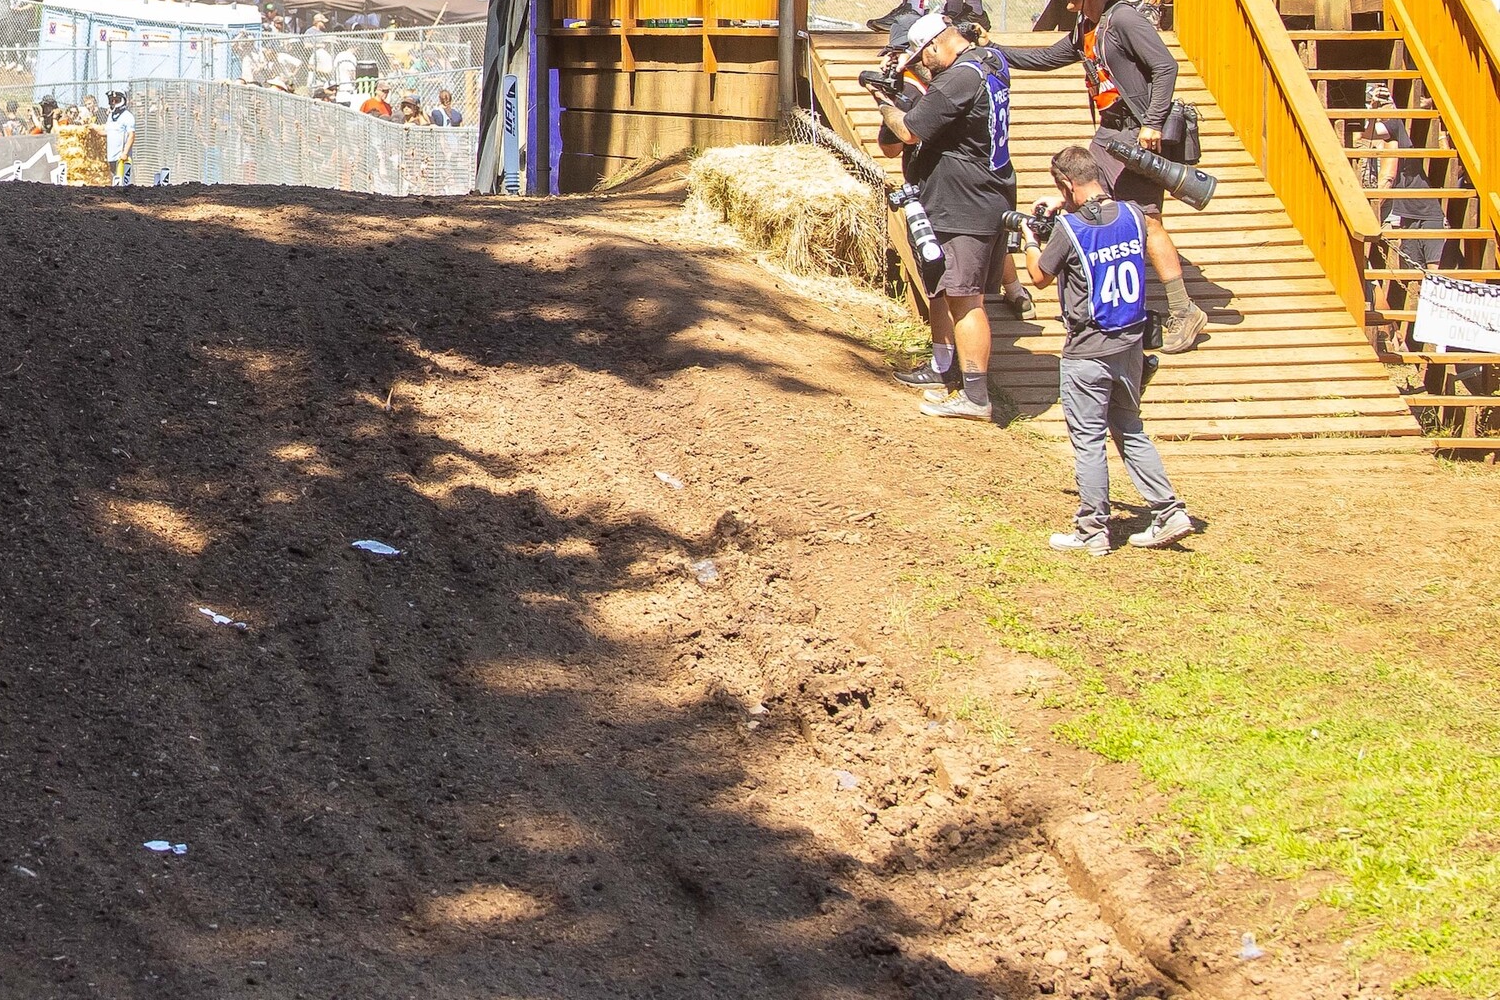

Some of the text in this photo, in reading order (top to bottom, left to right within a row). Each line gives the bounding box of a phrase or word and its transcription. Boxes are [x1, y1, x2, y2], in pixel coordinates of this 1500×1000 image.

[505, 98, 514, 135] UFO
[1088, 239, 1141, 267] PRESS
[1100, 260, 1140, 308] 40
[1449, 324, 1480, 344] ONLY
